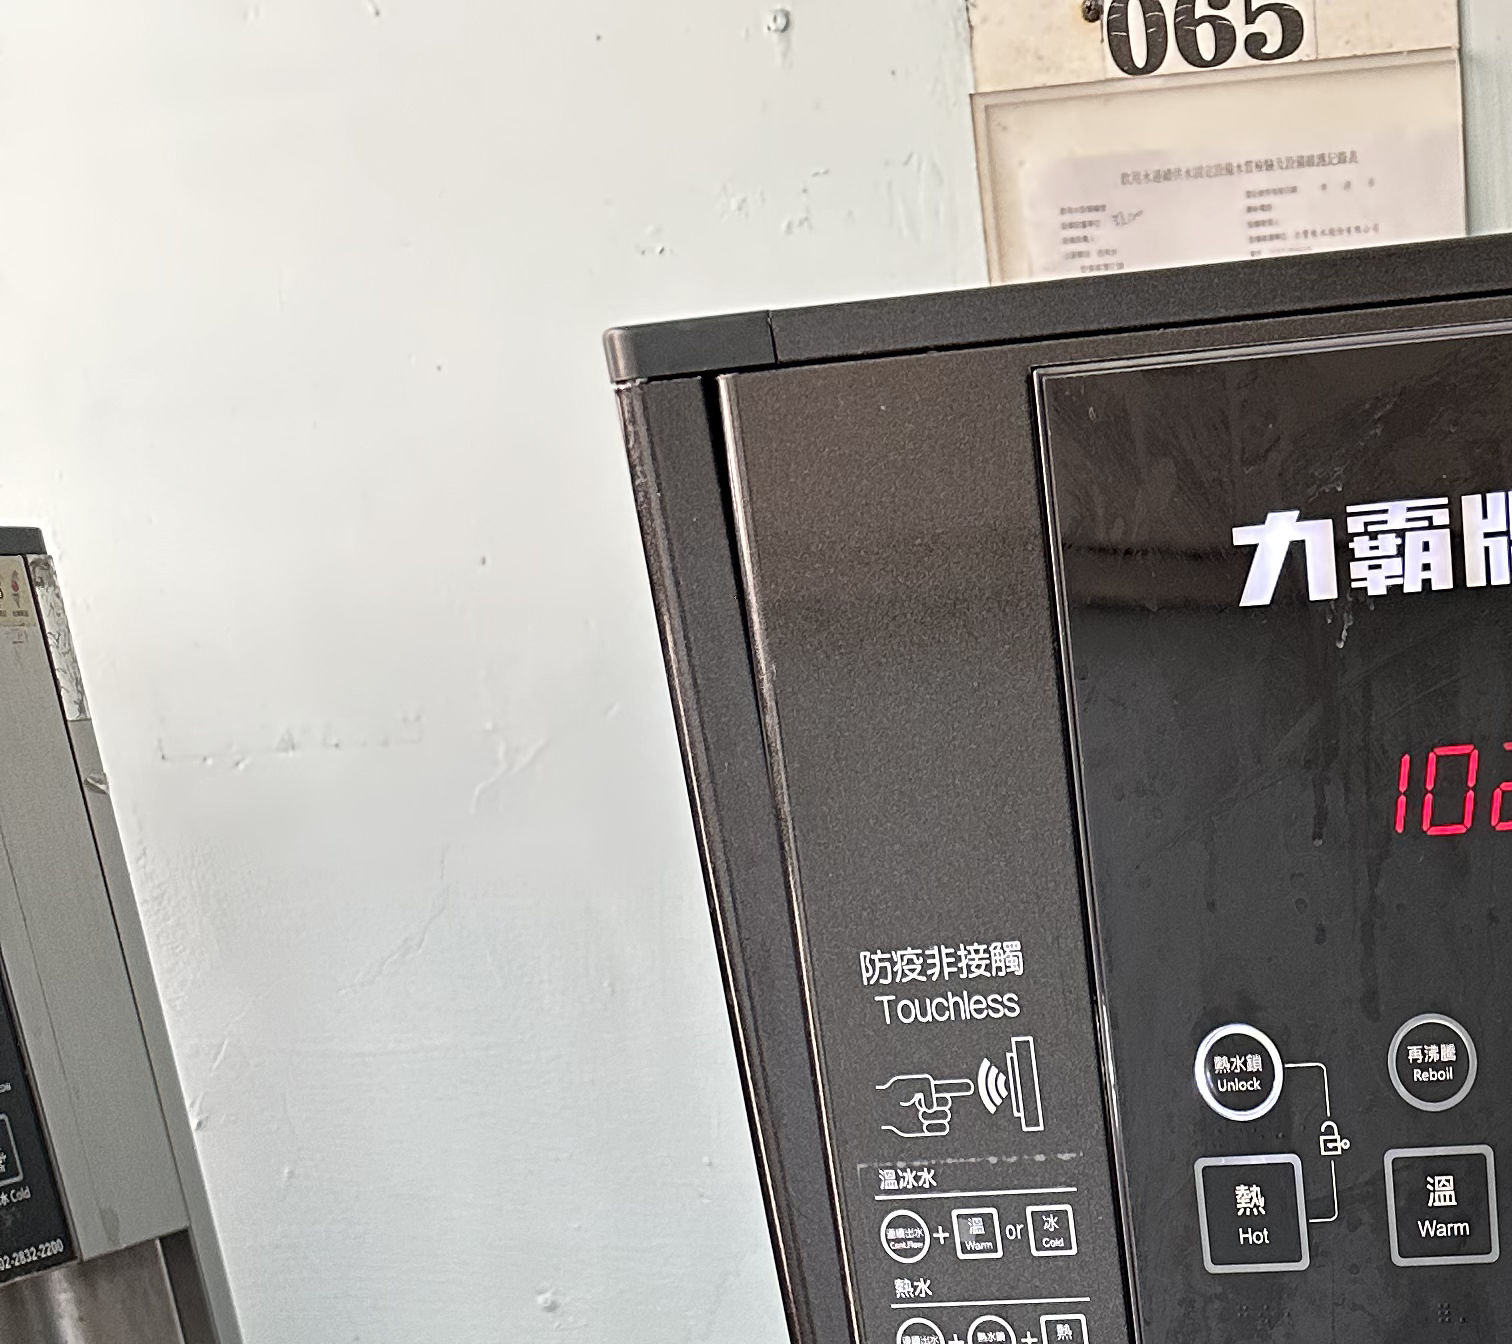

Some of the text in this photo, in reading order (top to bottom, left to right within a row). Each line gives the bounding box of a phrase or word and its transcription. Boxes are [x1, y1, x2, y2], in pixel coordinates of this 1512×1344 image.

[1107, 0, 1304, 76] 065
[859, 940, 1024, 986] 防疫非接觸
[874, 991, 1021, 1026] Touchless
[1407, 1043, 1457, 1064] 再沸騰
[1213, 1053, 1263, 1074] 熱水鎖
[1413, 1066, 1454, 1082] Reboil
[1217, 1077, 1262, 1092] Unlock
[878, 1167, 938, 1190] 溫冰水
[9, 1185, 32, 1203] Cold
[1234, 1183, 1266, 1216] 熱
[1426, 1175, 1458, 1207] 溫
[967, 1217, 986, 1235] 溫
[1005, 1223, 1025, 1240] or
[1042, 1213, 1060, 1232] 冰
[1417, 1219, 1470, 1238] Warm
[964, 1240, 994, 1251] Warm
[1042, 1237, 1065, 1248] Cold
[1238, 1227, 1270, 1245] Hot
[894, 1277, 933, 1299] 熱水
[1056, 1323, 1073, 1341] 熱
